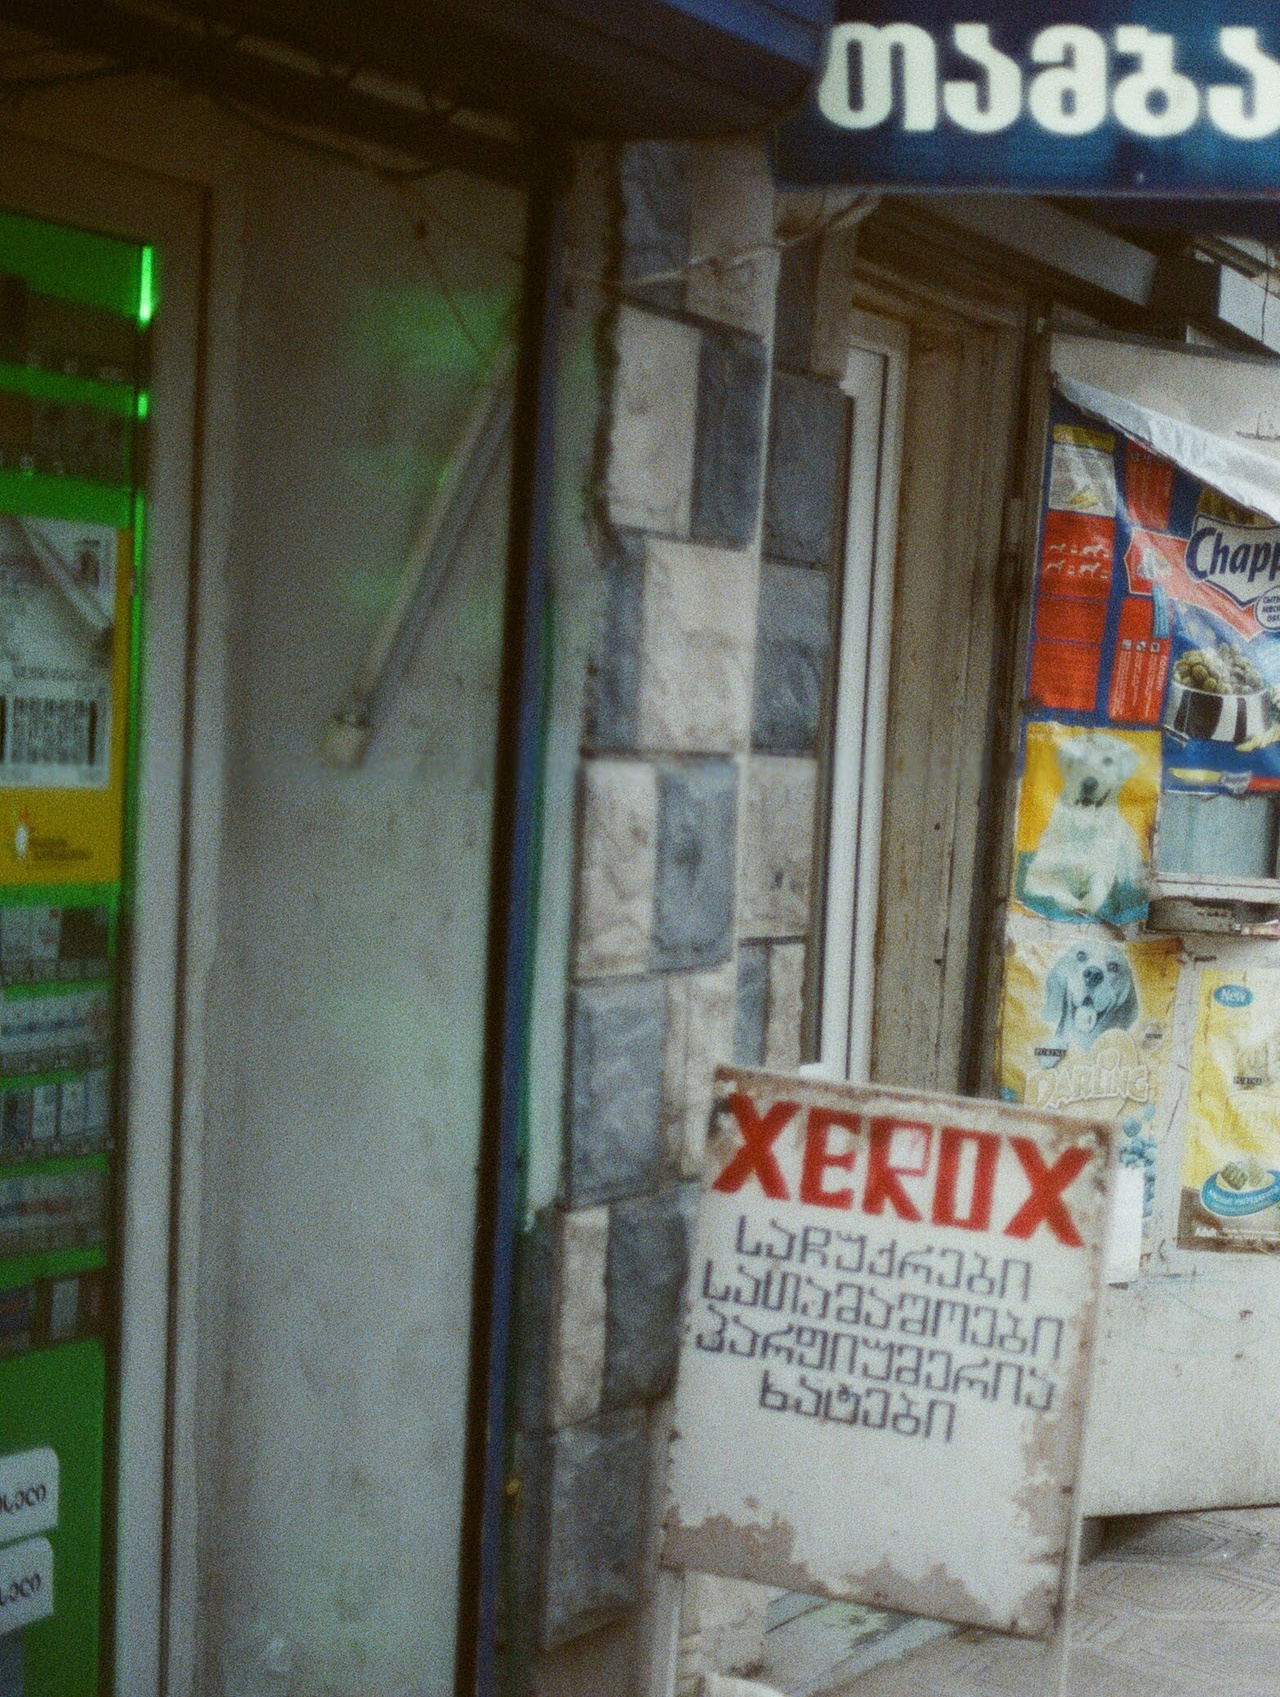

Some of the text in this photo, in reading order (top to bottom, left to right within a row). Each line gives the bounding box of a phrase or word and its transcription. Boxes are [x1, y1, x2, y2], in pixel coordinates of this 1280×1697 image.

[1220, 988, 1248, 1002] New
[712, 1092, 1093, 1248] XEROX
[735, 1215, 1032, 1300] საჩუქრები
[696, 1304, 1056, 1411] პარფიუმერია
[703, 1259, 1064, 1360] სათამაშოები
